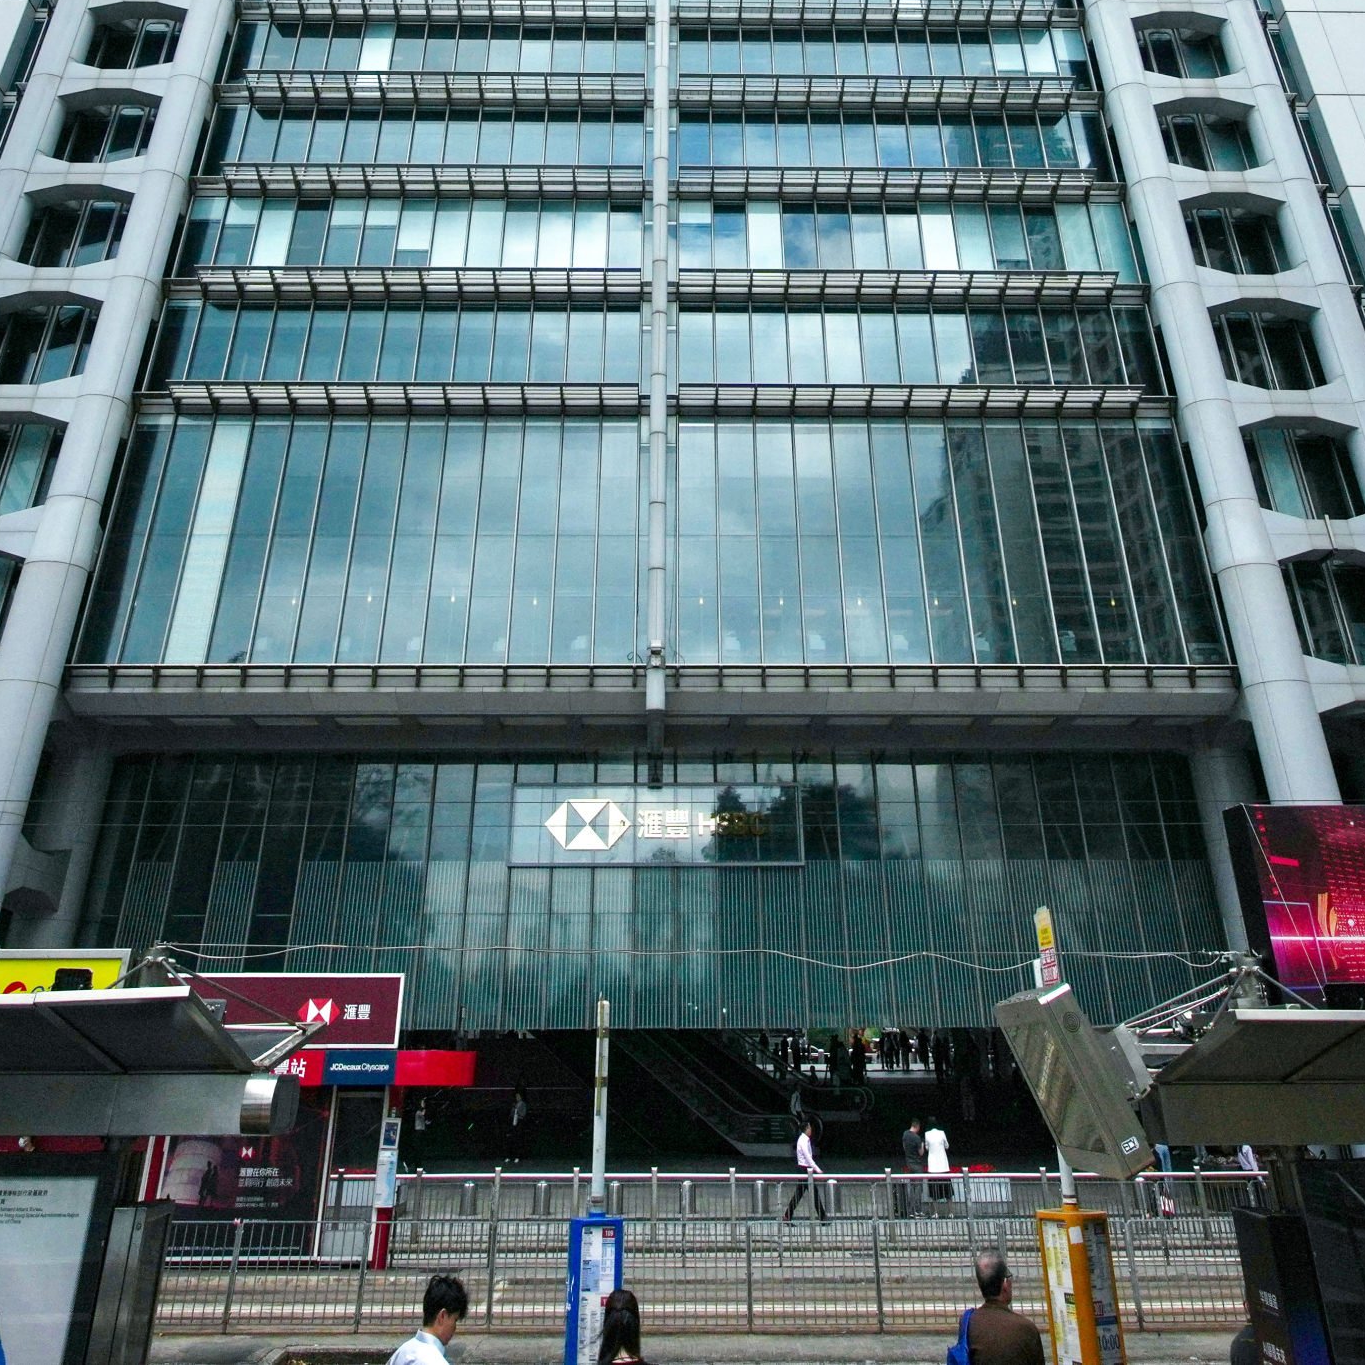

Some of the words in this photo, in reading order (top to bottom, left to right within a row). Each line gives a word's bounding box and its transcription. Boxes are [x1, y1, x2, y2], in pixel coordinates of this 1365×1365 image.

[698, 812, 764, 837] HSBC
[343, 1004, 371, 1020] 滙豐
[330, 1063, 361, 1072] JCDecaux
[361, 1063, 390, 1072] Cityscape
